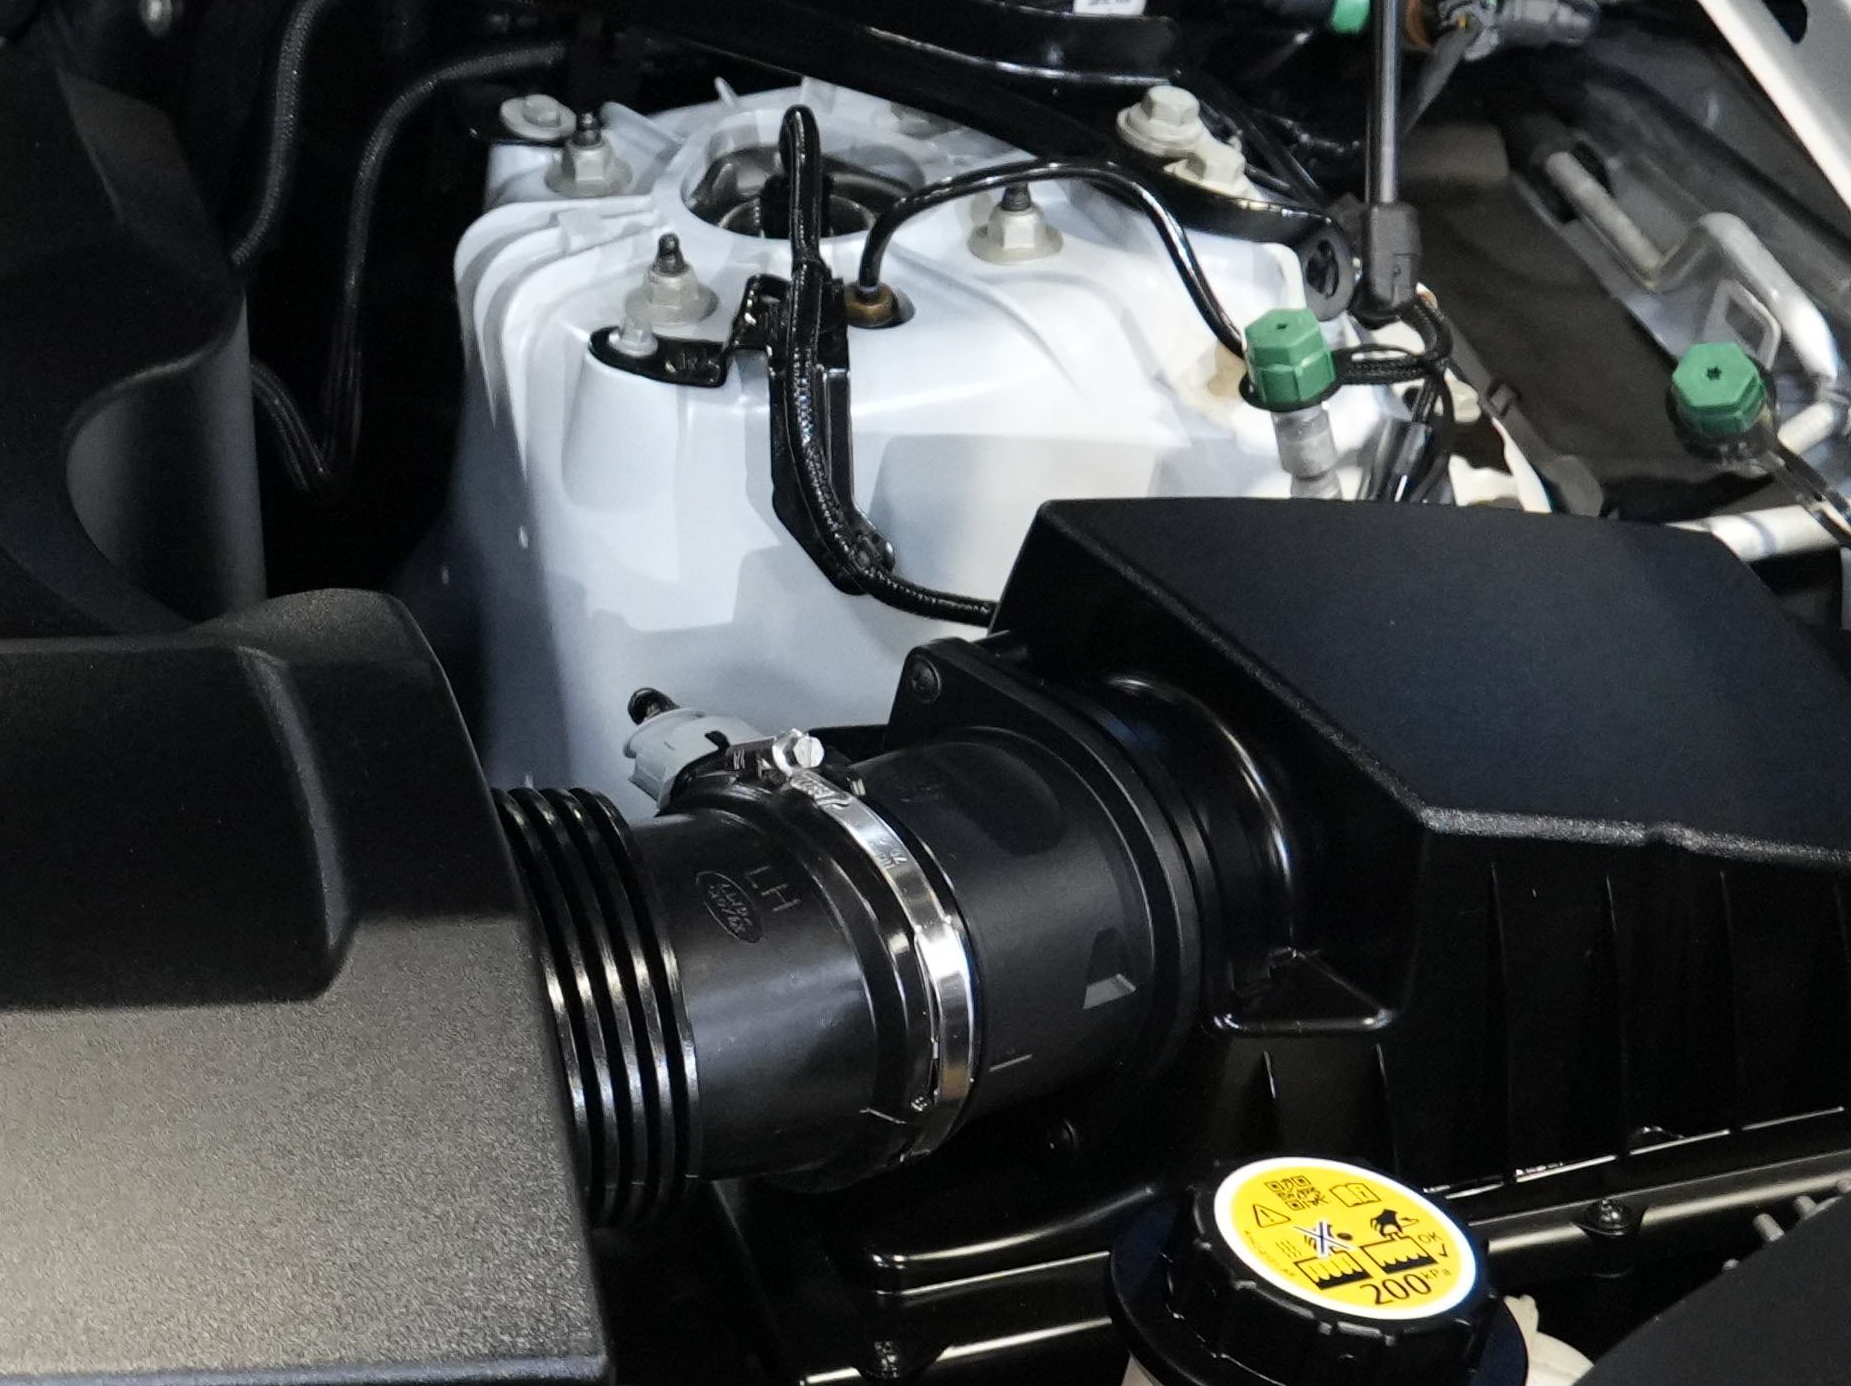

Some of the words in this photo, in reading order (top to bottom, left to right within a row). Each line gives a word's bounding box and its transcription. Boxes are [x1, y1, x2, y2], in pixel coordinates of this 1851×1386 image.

[745, 865, 801, 912] LH
[1420, 1231, 1440, 1245] OK
[1359, 1273, 1432, 1306] 200
